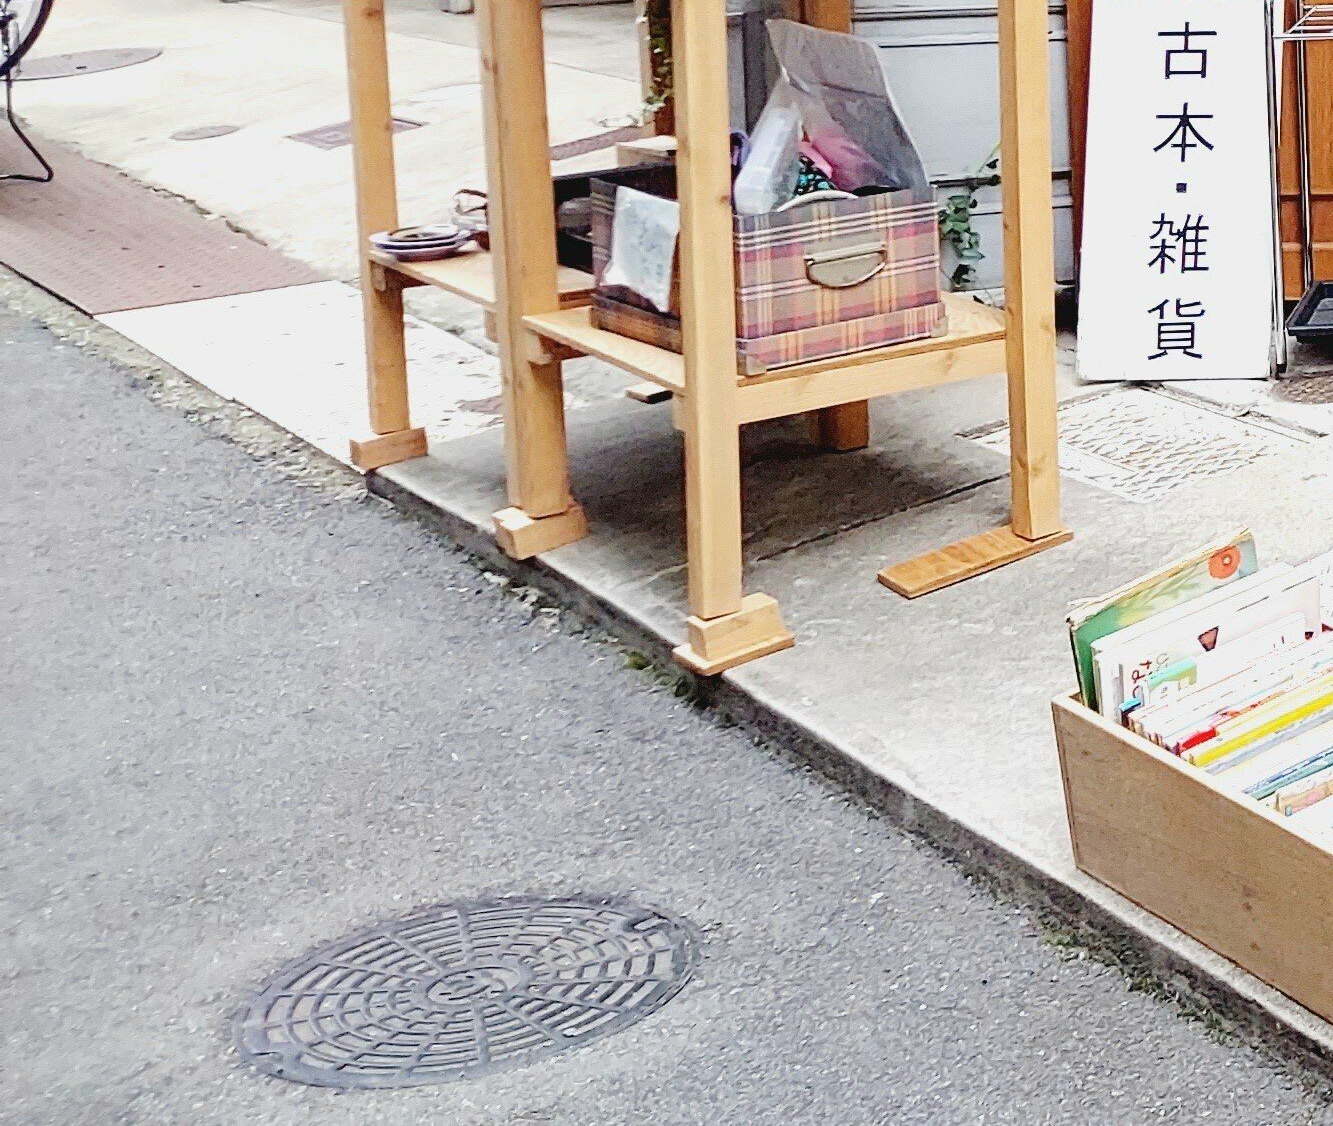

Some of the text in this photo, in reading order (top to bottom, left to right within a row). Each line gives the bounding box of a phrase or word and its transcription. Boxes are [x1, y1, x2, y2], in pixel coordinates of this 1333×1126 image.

[1146, 22, 1218, 360] 古本・雑貨
